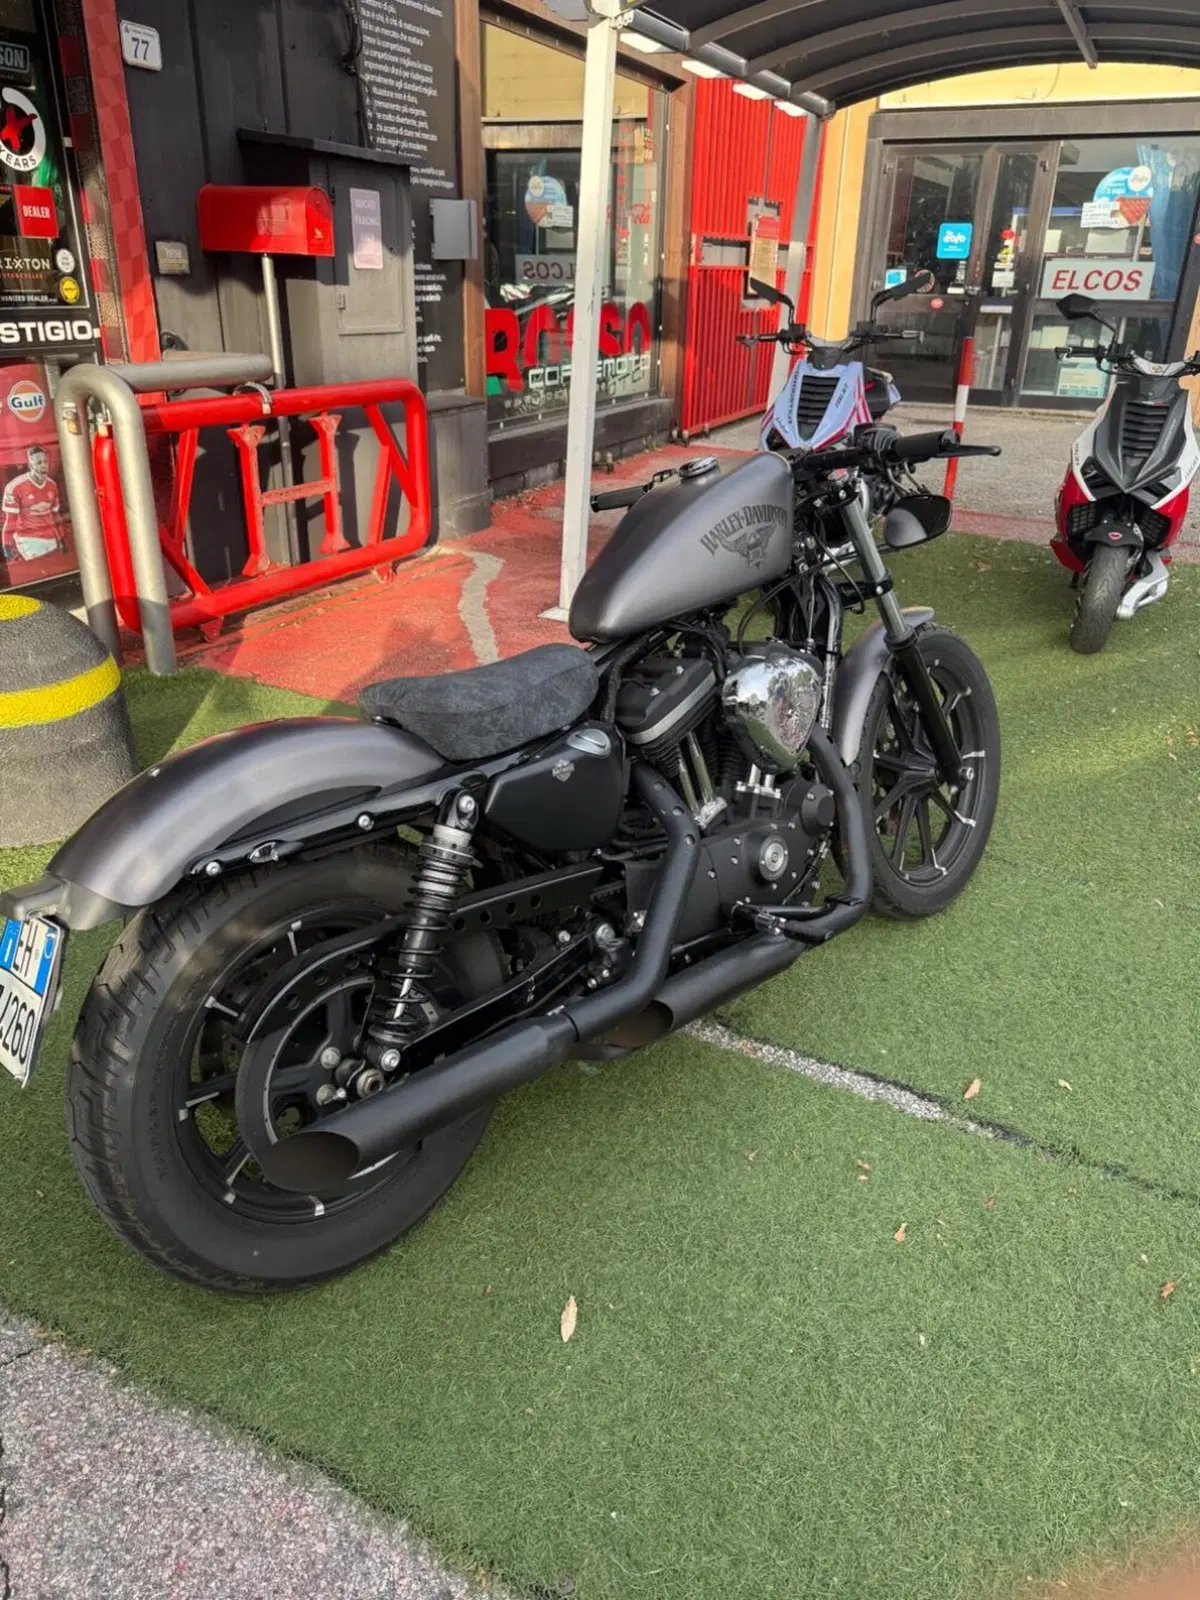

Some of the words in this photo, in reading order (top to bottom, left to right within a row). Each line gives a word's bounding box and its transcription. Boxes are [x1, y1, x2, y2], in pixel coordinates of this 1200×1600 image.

[131, 36, 150, 61] 77
[22, 204, 51, 219] DEALER
[1051, 269, 1143, 291] ELCOS
[485, 302, 653, 391] ROSO
[11, 395, 44, 409] Gulf
